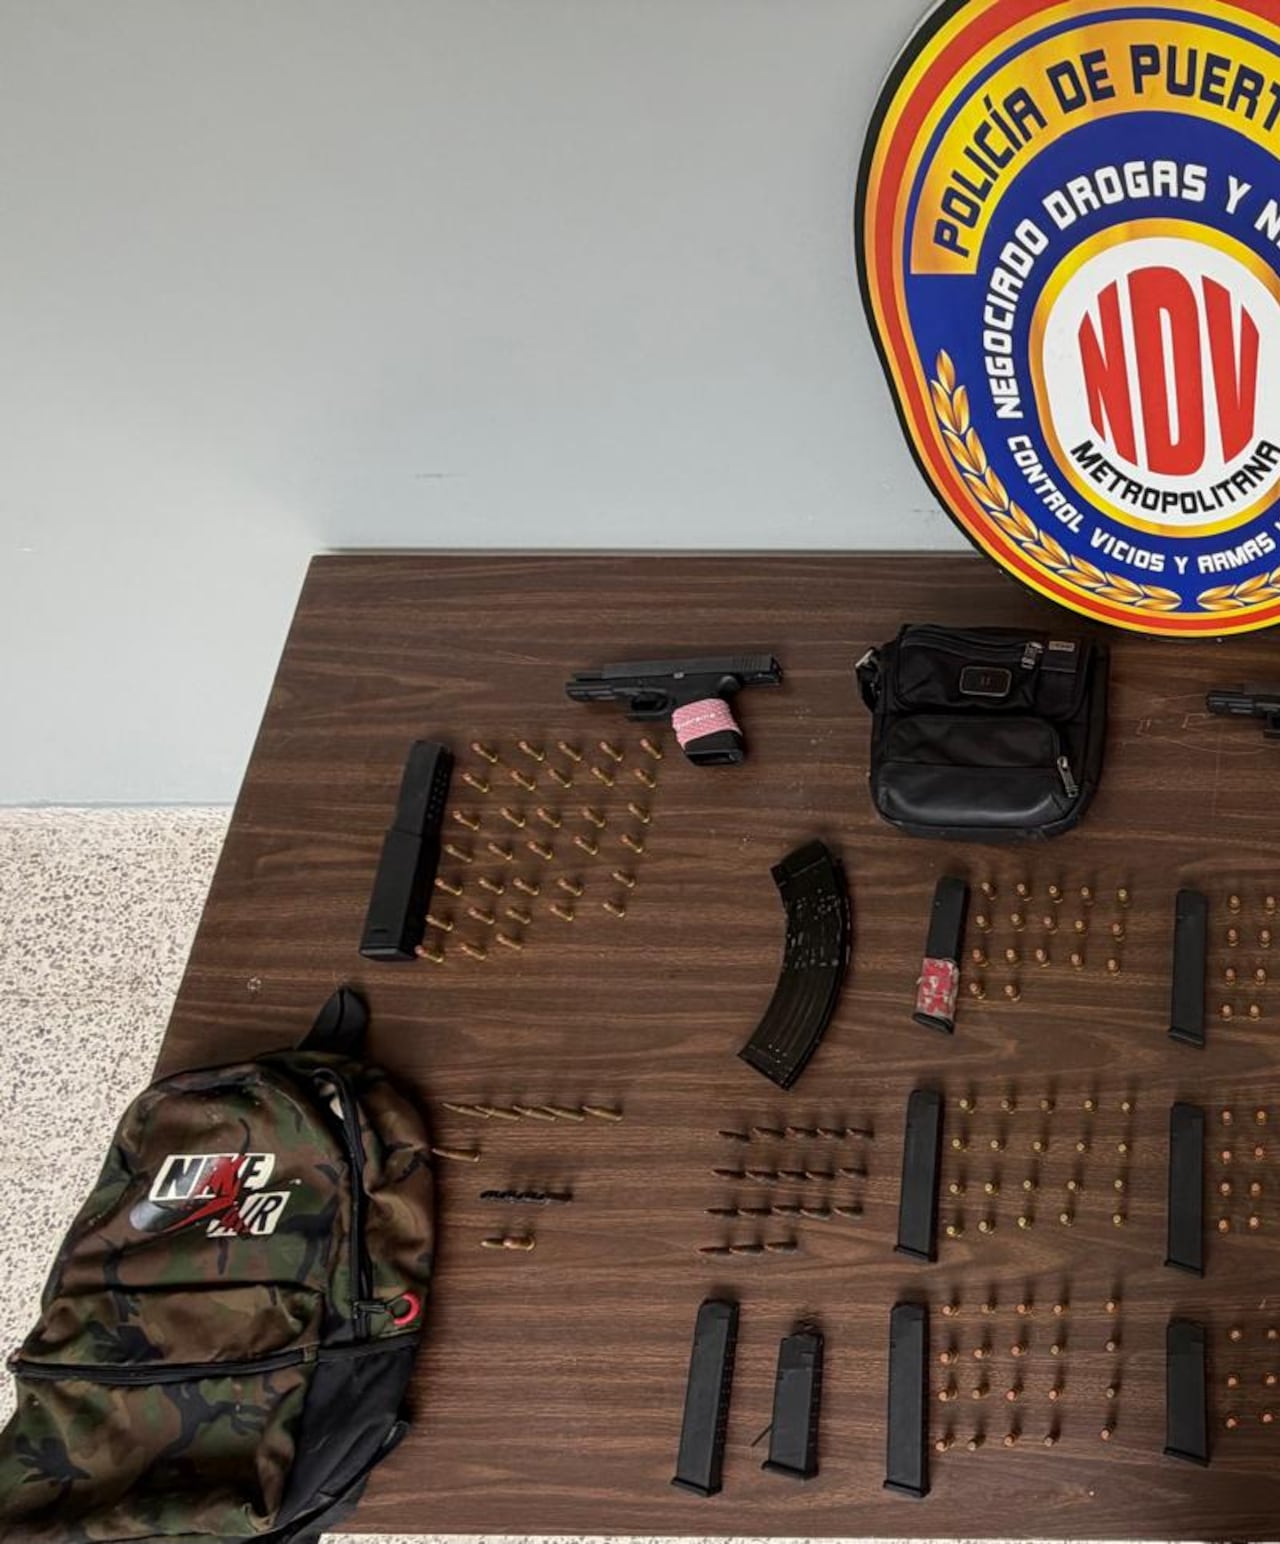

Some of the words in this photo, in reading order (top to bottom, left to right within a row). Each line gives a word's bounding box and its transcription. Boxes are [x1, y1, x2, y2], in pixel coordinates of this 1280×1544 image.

[933, 87, 1048, 258] POLICÍA
[1046, 49, 1116, 114] DE
[983, 218, 1049, 419] NEGOCIADO
[1042, 160, 1208, 231] DROGAS
[1225, 175, 1252, 215] Y
[1078, 265, 1260, 477] NDV
[1007, 434, 1085, 533] CONTROL
[1089, 527, 1165, 573] VICIOS
[1174, 556, 1188, 575] Y
[1198, 532, 1276, 574] ARMAS
[156, 1155, 266, 1199] NIE
[208, 1194, 283, 1235] IR
